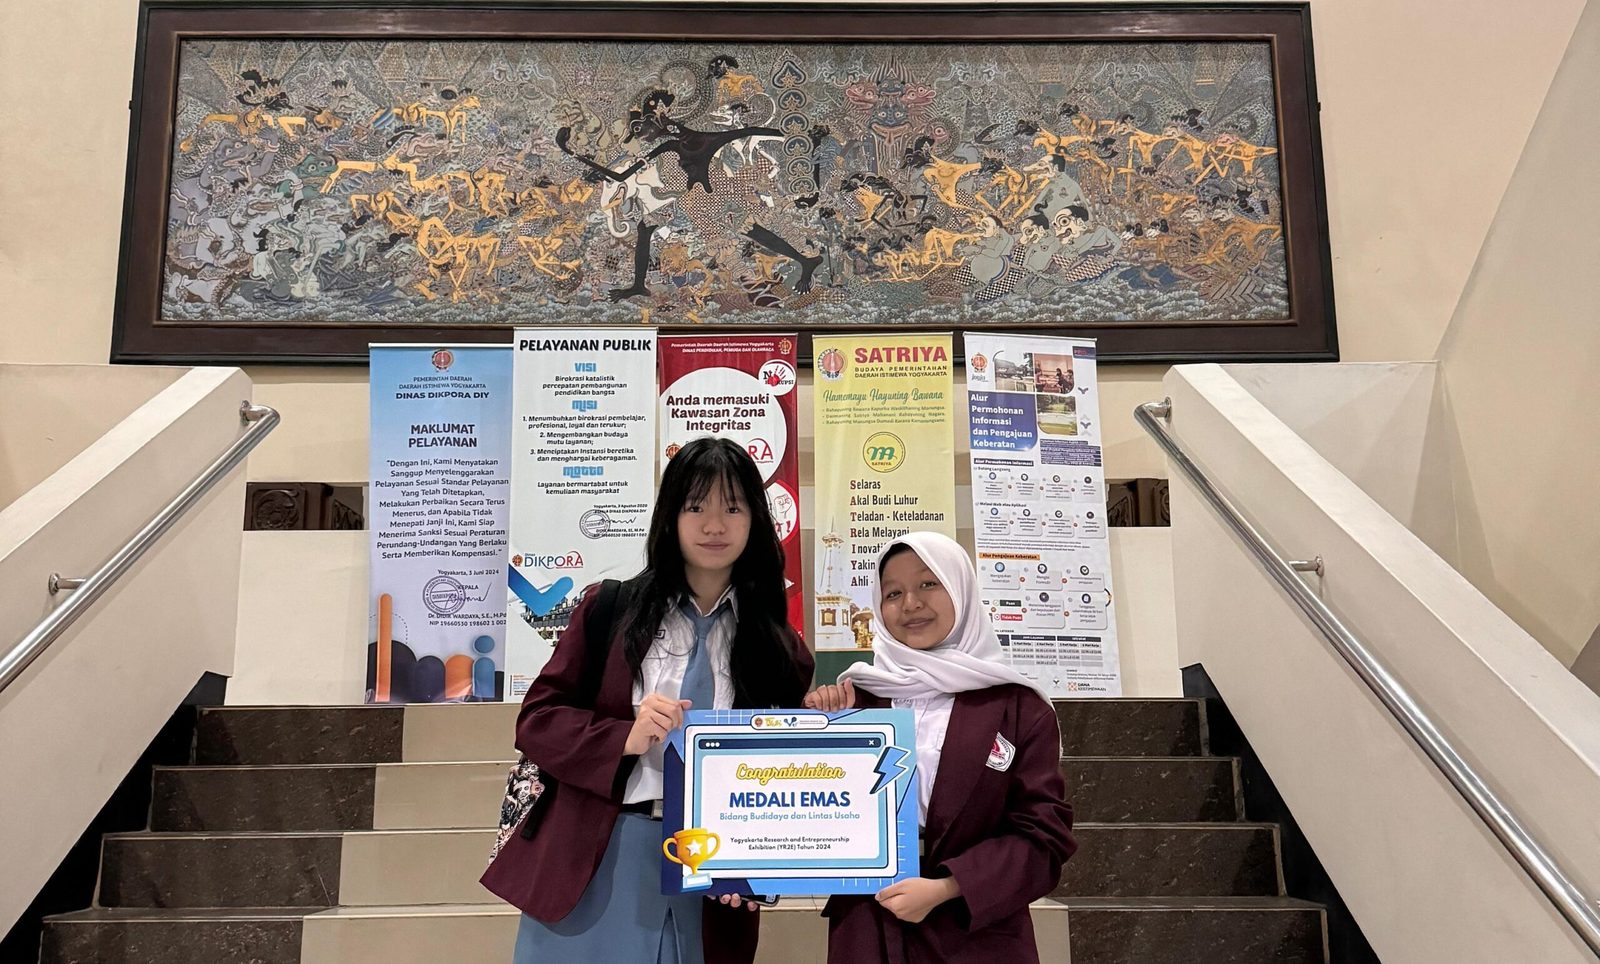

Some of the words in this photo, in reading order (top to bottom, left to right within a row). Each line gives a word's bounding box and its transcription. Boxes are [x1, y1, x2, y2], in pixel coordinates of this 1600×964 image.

[519, 340, 599, 351] PELAYANAN
[603, 340, 651, 350] PUBLIK
[855, 347, 948, 363] SATRIYA
[575, 363, 596, 372] VISI
[667, 395, 700, 405] Anda
[704, 394, 769, 405] memasuki
[823, 390, 866, 405] Hamemayu
[870, 388, 908, 404] Hayuning
[911, 388, 943, 400] Bawana
[572, 400, 597, 412] MISI
[972, 406, 1024, 414] Permohonan
[672, 408, 729, 418] Kawasan
[733, 407, 765, 417] Zona
[686, 420, 750, 432] Integritas
[972, 417, 1012, 425] Informasi
[411, 424, 475, 434] MAKLUMAT
[990, 429, 1032, 439] Pengajuan
[409, 437, 477, 448] PELAYANAN
[974, 440, 1015, 448] Keberatan
[391, 470, 423, 478] Sanggup
[425, 469, 494, 477] Menyelenggarakan
[375, 480, 413, 488] Pelayanan
[472, 478, 508, 486] Pelayanan
[850, 479, 881, 490] Selaras
[401, 490, 419, 498] Yang
[442, 488, 485, 497] Ditetapkan,
[380, 500, 420, 508] Melakukan
[850, 495, 869, 506] Akal
[872, 495, 891, 505] Budi
[894, 495, 918, 505] Luhur
[392, 510, 426, 518] Menerus,
[850, 511, 884, 522] Teladan
[893, 510, 944, 521] Keteladanan
[390, 520, 424, 528] Menepati
[479, 519, 494, 527] Siap
[850, 528, 869, 538] Rela
[872, 527, 909, 539] Melayani
[377, 540, 457, 549] Perundang-Undangan
[459, 540, 477, 548] Yang
[524, 551, 584, 569] DIKPORA
[851, 560, 875, 570] Yakin
[851, 576, 868, 586] Ahli
[736, 763, 846, 786] Congratulation
[729, 792, 795, 807] MEDALI
[801, 792, 850, 807] EMAS
[720, 812, 748, 821] Bidang
[750, 812, 789, 821] Budidaya
